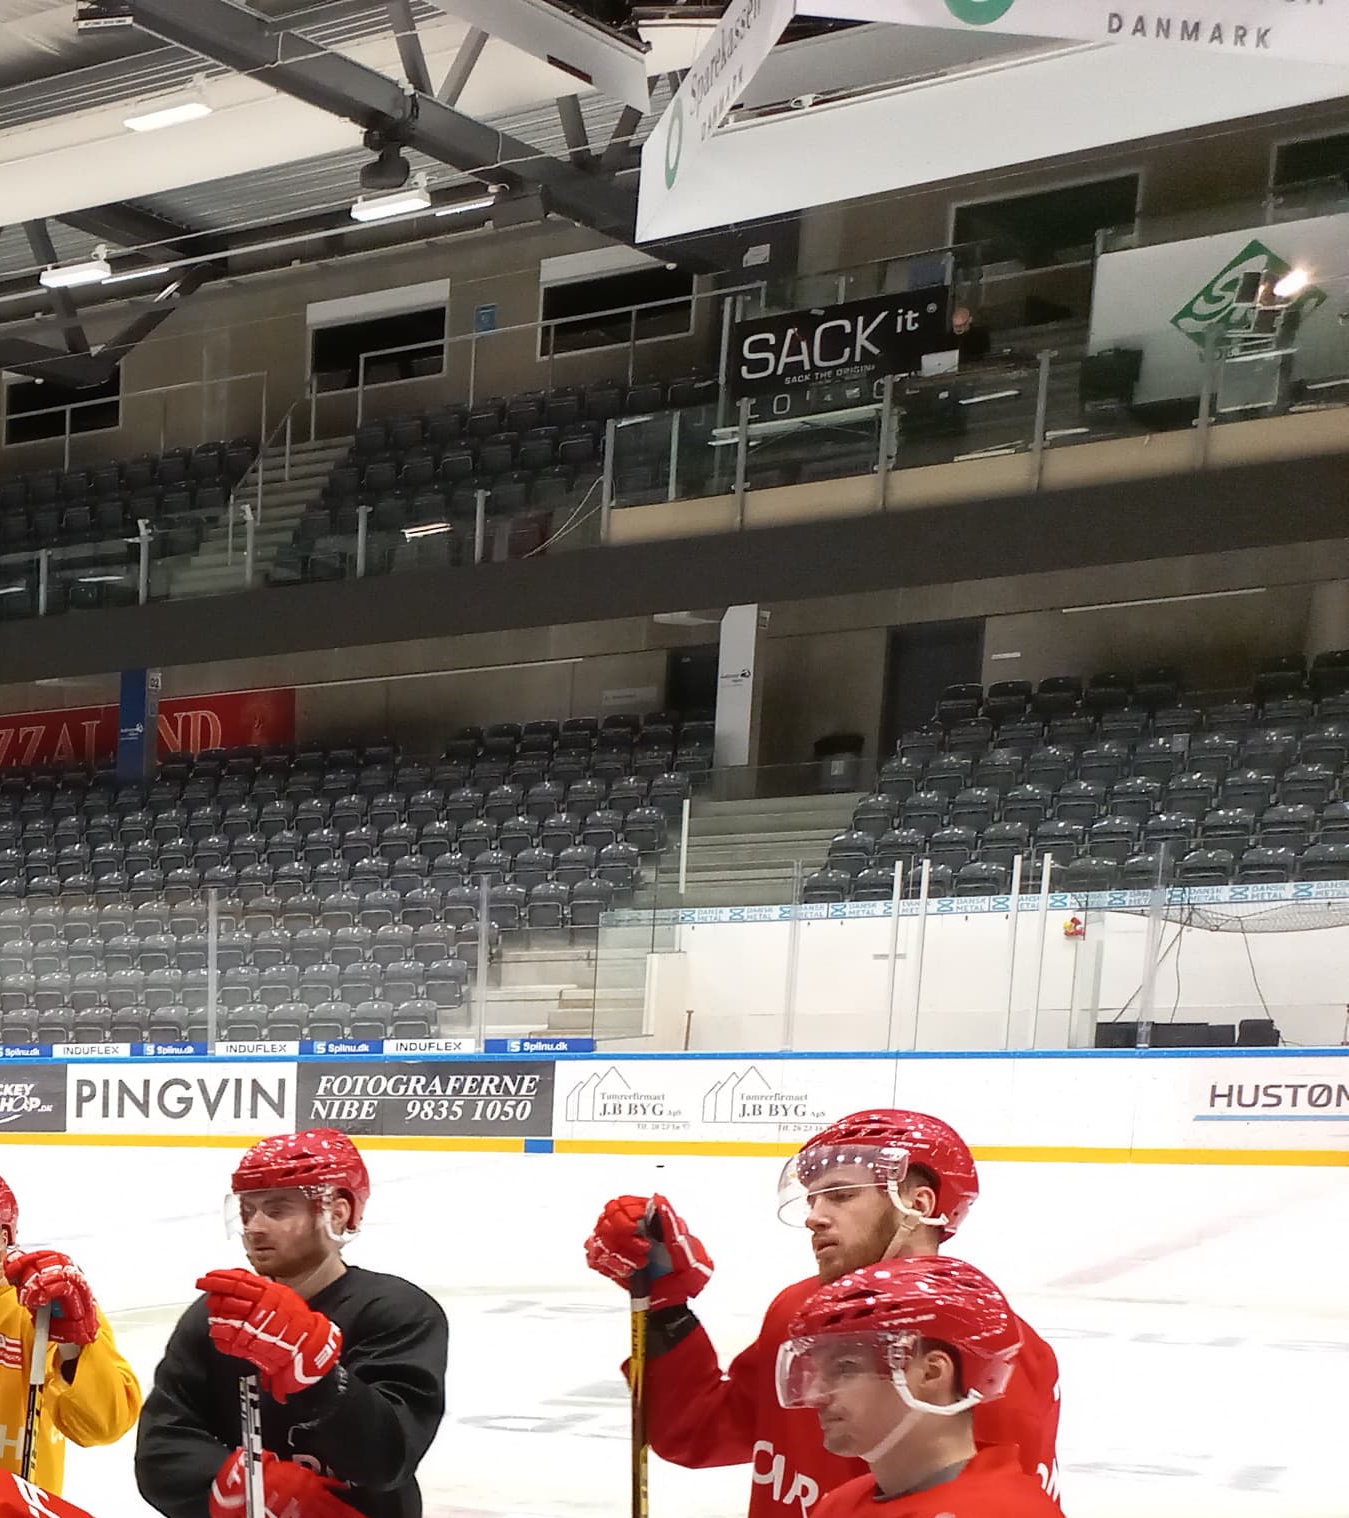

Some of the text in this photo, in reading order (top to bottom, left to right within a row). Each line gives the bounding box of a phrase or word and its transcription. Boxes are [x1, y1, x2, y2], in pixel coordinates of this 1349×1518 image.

[1108, 12, 1273, 50] DANMARK
[741, 309, 919, 380] SACK it
[62, 1045, 120, 1056] INDUFLEX
[225, 1043, 287, 1055] INDUFLEX
[395, 1040, 462, 1053] INDUFLEX
[315, 1073, 540, 1097] FOTOGRAFERNE
[75, 1077, 287, 1121] PINGVIN
[309, 1099, 533, 1122] NIBE 9835 1050
[599, 1103, 623, 1118] J.B
[627, 1103, 664, 1118] BYG
[738, 1104, 763, 1119] J.B
[767, 1104, 807, 1119] BYG
